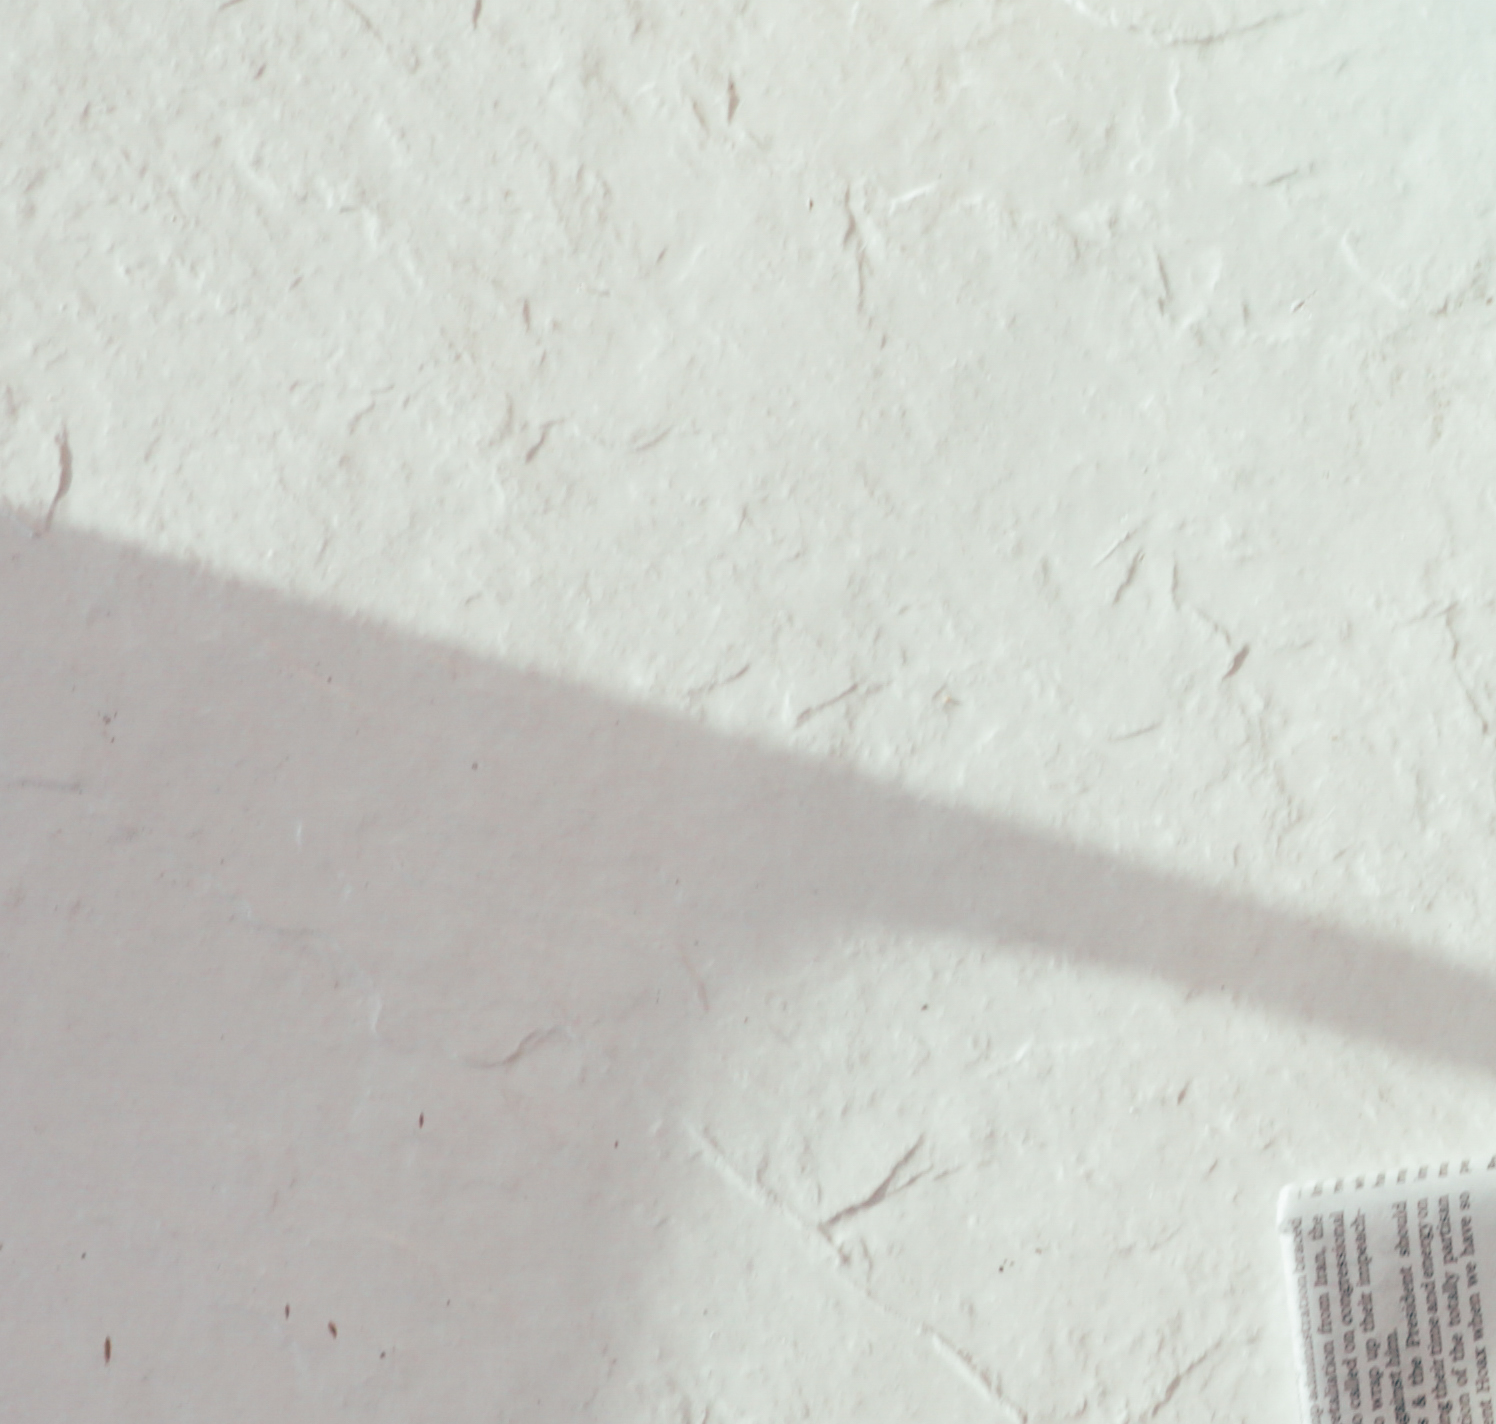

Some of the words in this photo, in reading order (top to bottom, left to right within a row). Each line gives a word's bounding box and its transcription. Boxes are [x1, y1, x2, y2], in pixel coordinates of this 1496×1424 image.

[1350, 1209, 1373, 1287] impeach-
[1392, 1200, 1411, 1258] should
[1418, 1222, 1435, 1278] energy
[1436, 1195, 1459, 1265] partisan
[1459, 1216, 1475, 1257] have
[1357, 1291, 1376, 1333] their
[1399, 1266, 1421, 1349] President
[1421, 1281, 1438, 1315] and
[1441, 1271, 1462, 1327] totally
[1467, 1292, 1484, 1342] when
[1384, 1327, 1401, 1368] him.
[1428, 1317, 1443, 1355] time
[1448, 1332, 1466, 1363] the
[1368, 1366, 1384, 1411] wrap
[1407, 1356, 1425, 1387] the
[1429, 1358, 1447, 1399] their
[1474, 1346, 1491, 1393] Hoax
